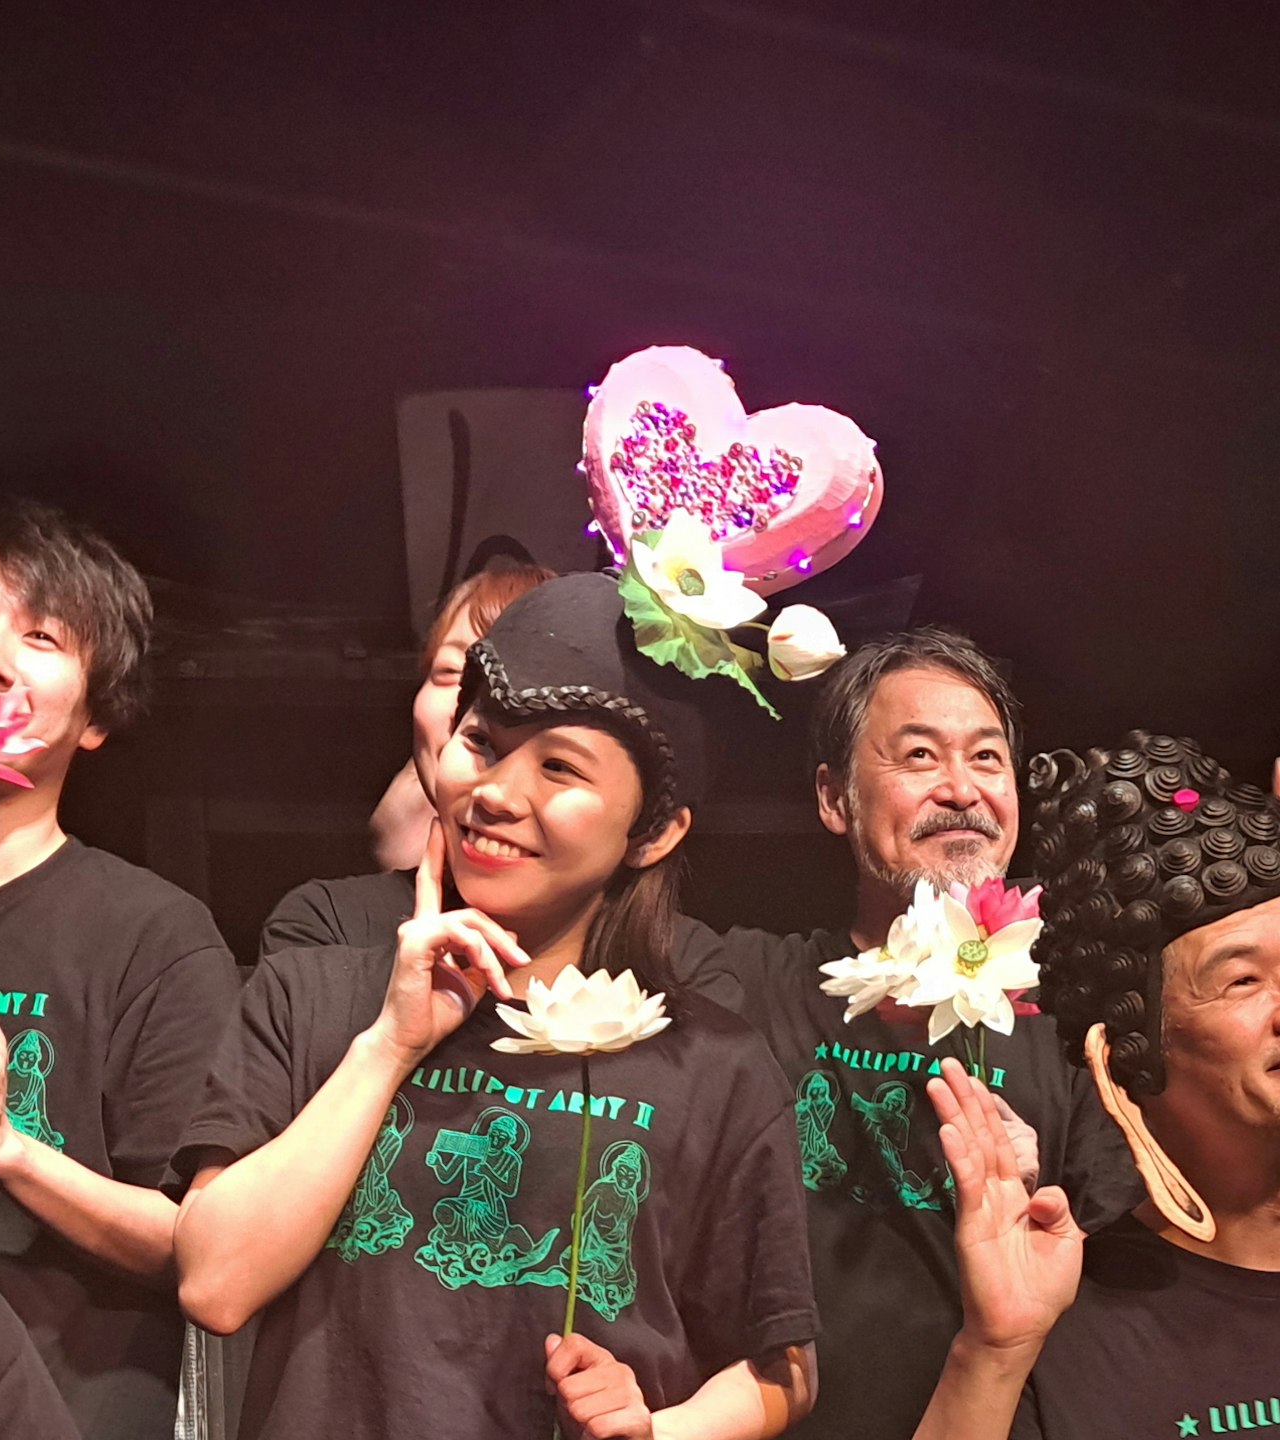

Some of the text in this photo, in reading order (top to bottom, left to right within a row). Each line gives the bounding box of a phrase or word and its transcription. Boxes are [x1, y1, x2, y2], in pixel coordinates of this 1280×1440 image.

[832, 1041, 925, 1073] LILLIPUT
[411, 1067, 546, 1110] LILLIPUT
[548, 1089, 627, 1121] ARMY
